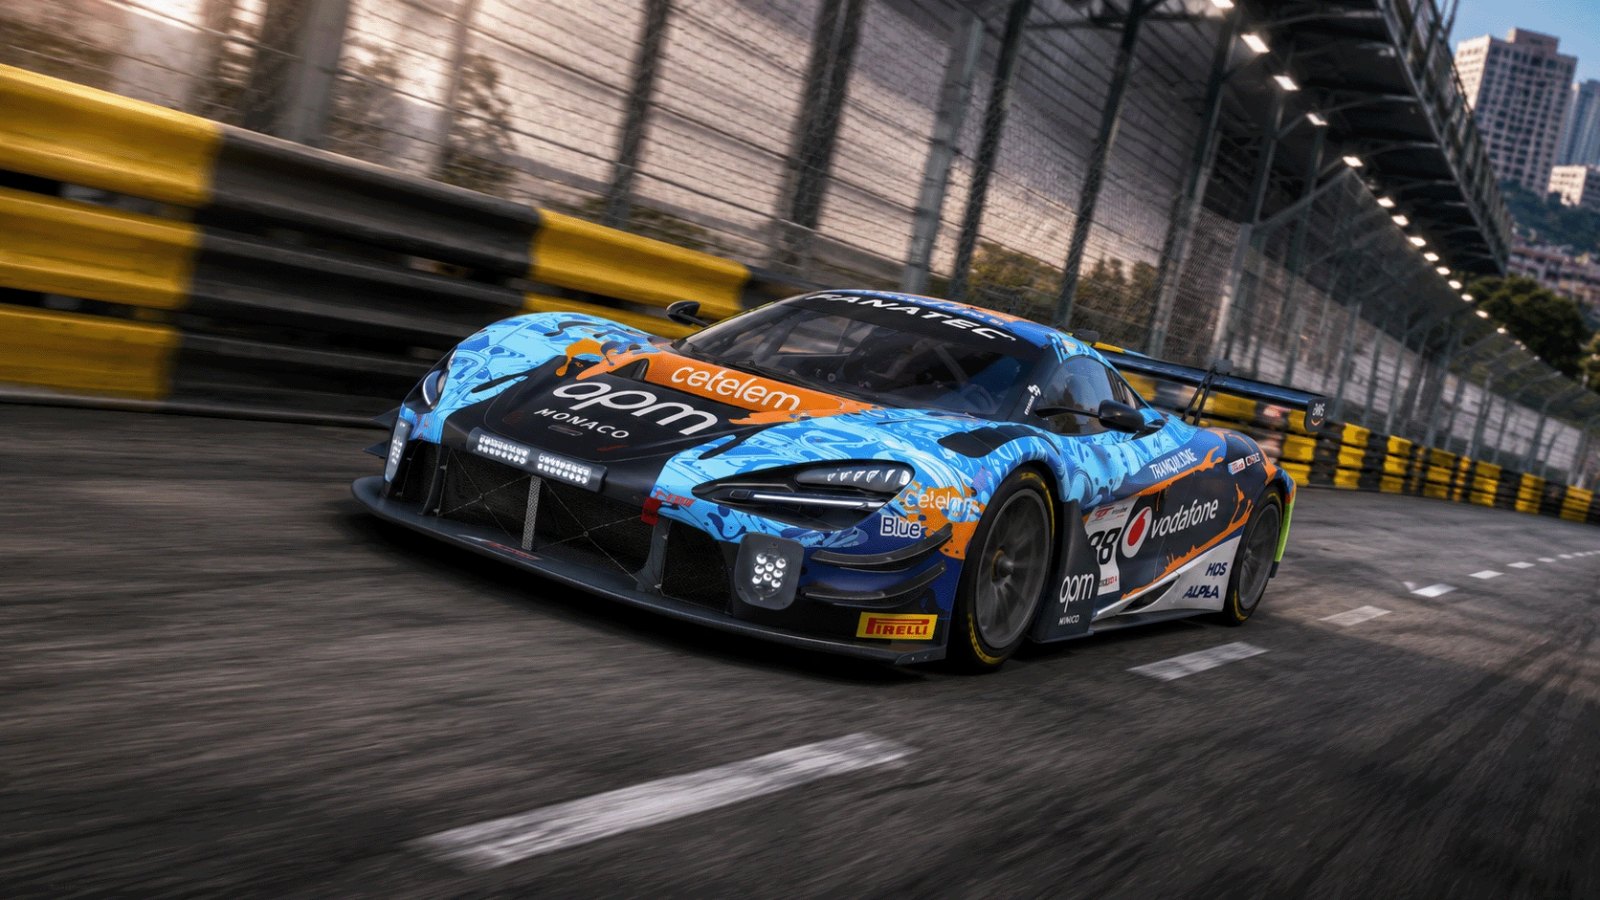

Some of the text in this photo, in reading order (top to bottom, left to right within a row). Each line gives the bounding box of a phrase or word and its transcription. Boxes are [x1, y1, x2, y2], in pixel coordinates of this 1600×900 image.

[670, 366, 801, 411] cetelem
[534, 408, 630, 439] MONACO
[553, 382, 718, 436] apm
[881, 515, 921, 538] Blue
[1151, 499, 1219, 539] vodafone
[865, 617, 930, 635] PIRELLI
